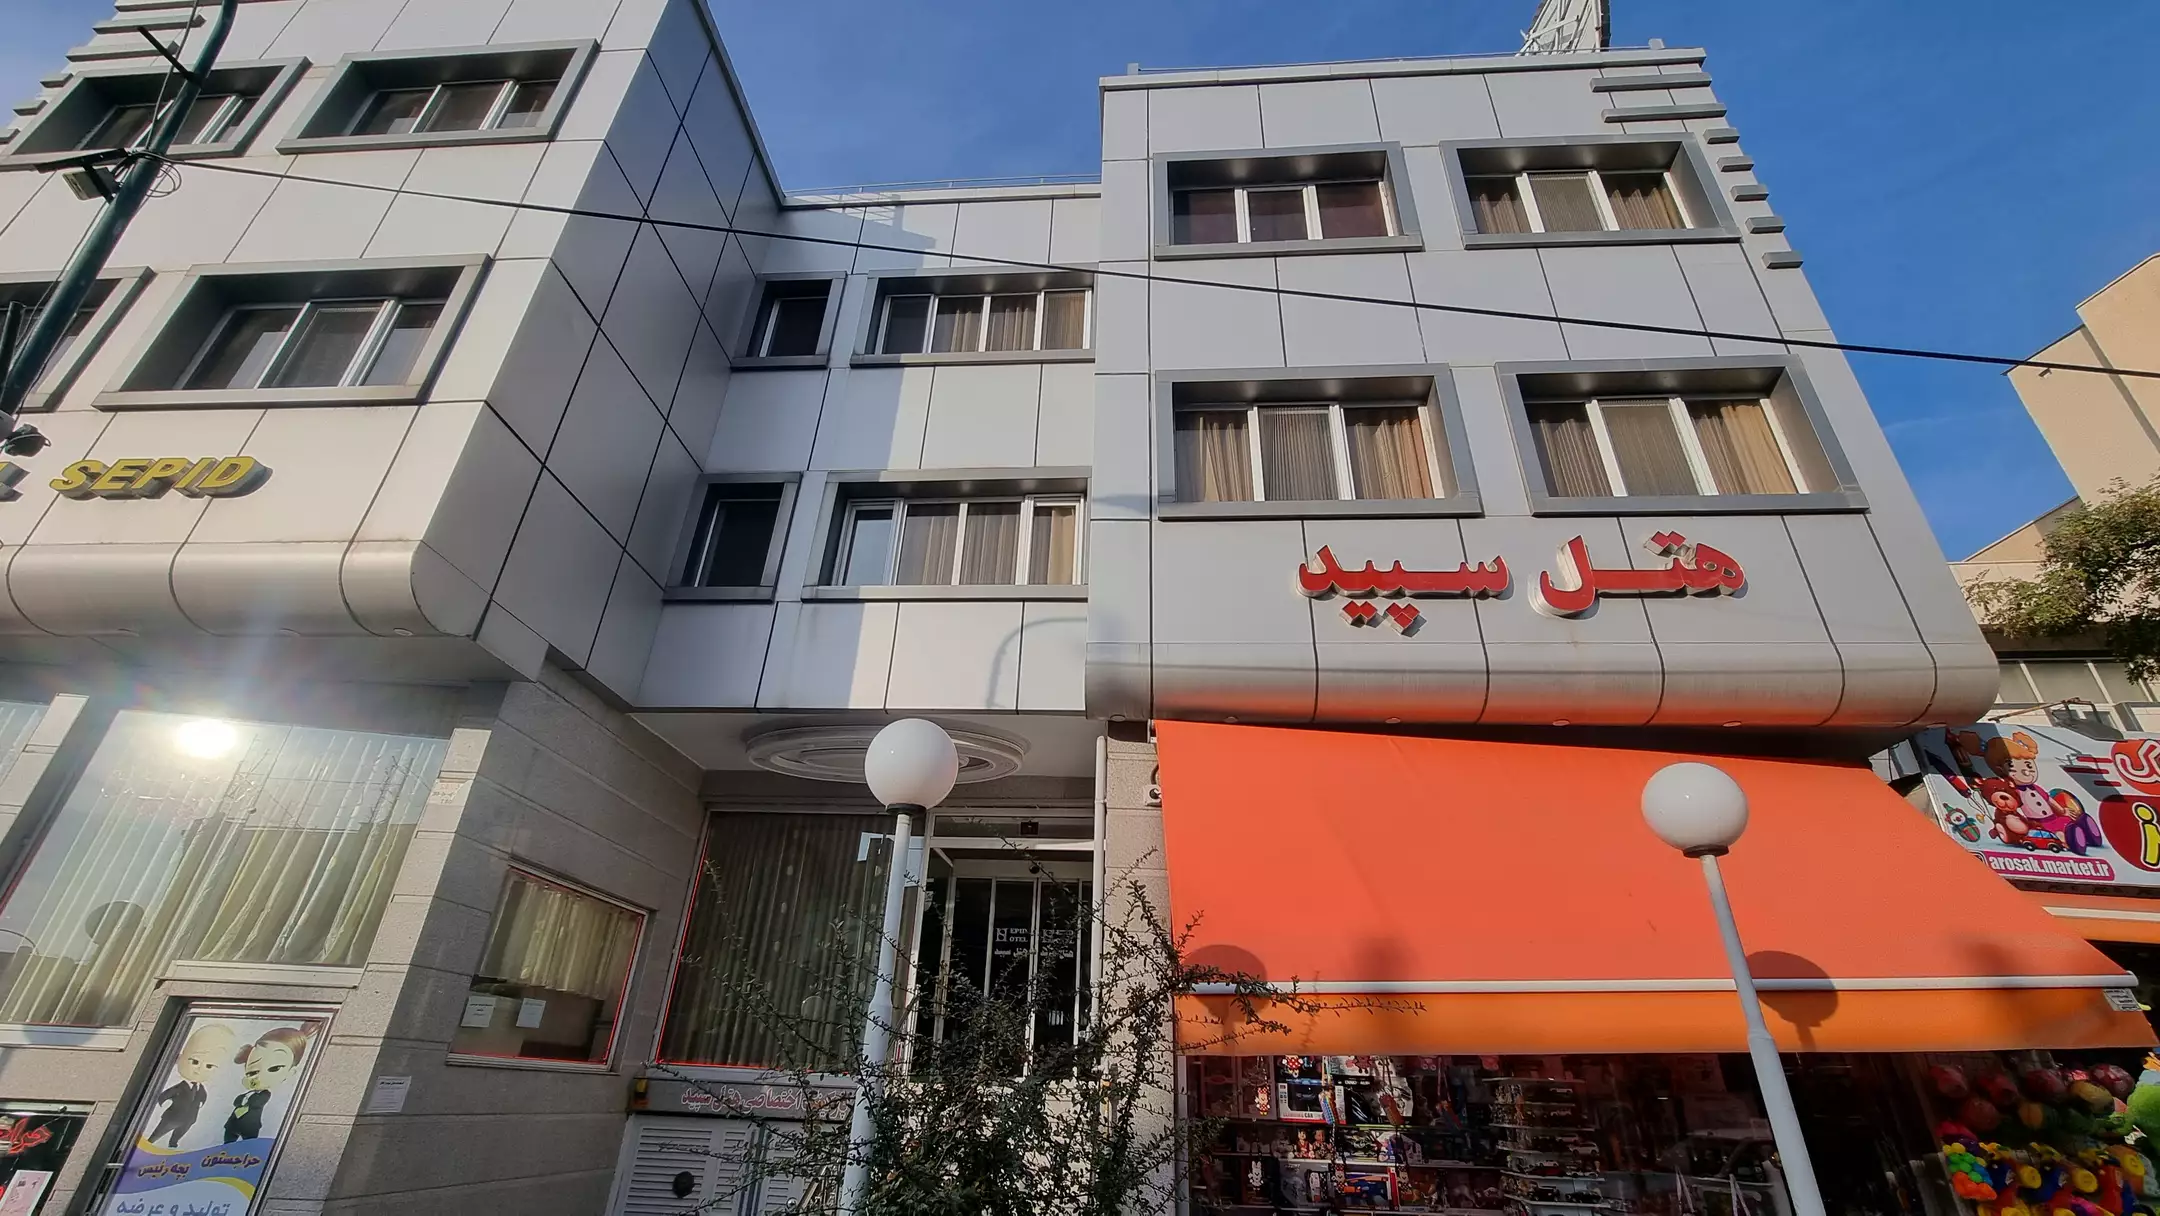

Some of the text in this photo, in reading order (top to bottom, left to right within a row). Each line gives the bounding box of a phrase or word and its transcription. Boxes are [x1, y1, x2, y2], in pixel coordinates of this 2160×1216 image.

[49, 456, 270, 499] SEPID
[1296, 529, 1747, 636] هتل سپید
[1988, 856, 2111, 877] arosak.market.ir
[681, 1088, 712, 1112] سپید
